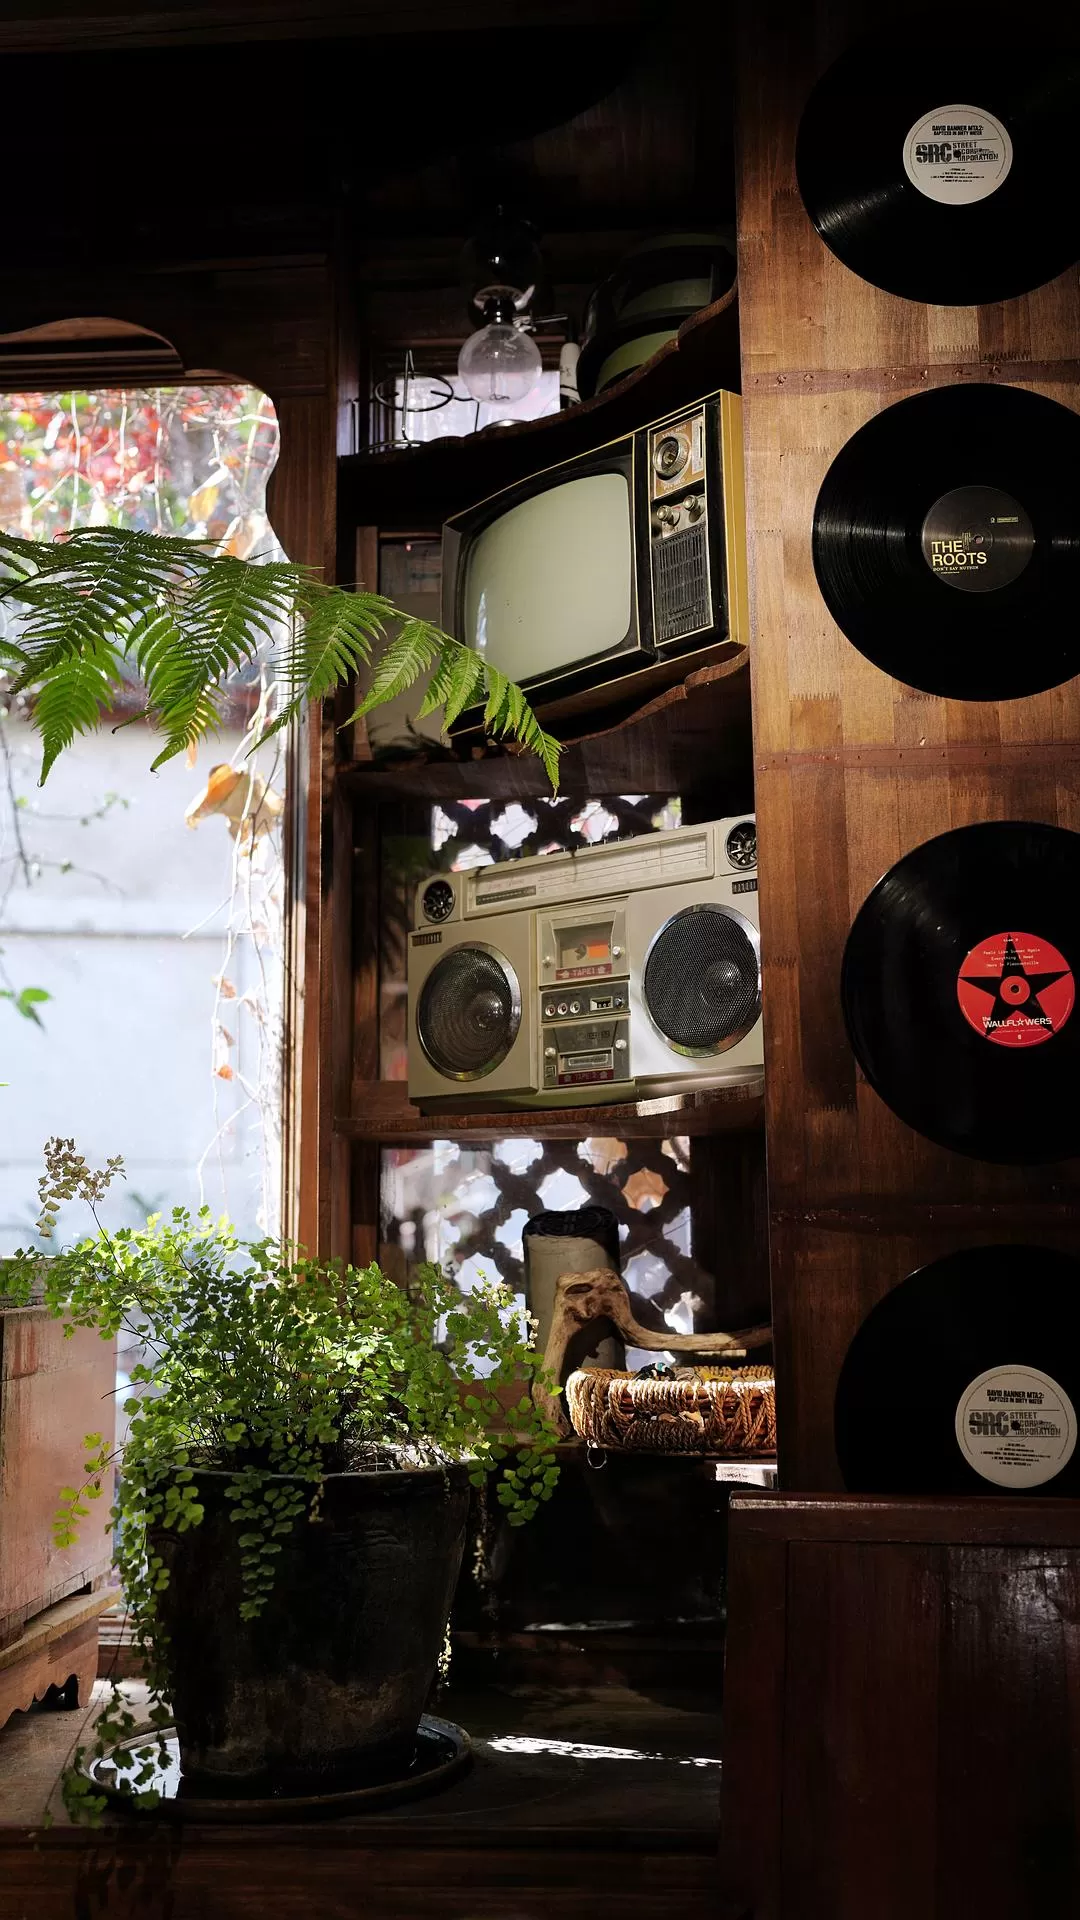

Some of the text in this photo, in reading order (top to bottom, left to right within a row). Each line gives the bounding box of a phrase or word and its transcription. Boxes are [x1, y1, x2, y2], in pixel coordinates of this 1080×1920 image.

[916, 142, 952, 163] SRC
[957, 153, 998, 161] ORPORATION
[932, 540, 963, 553] THE
[932, 552, 987, 566] ROOTS
[1004, 1390, 1026, 1398] BANNER
[969, 1412, 1009, 1436] SRC
[1016, 1427, 1061, 1436] ORPORATION
